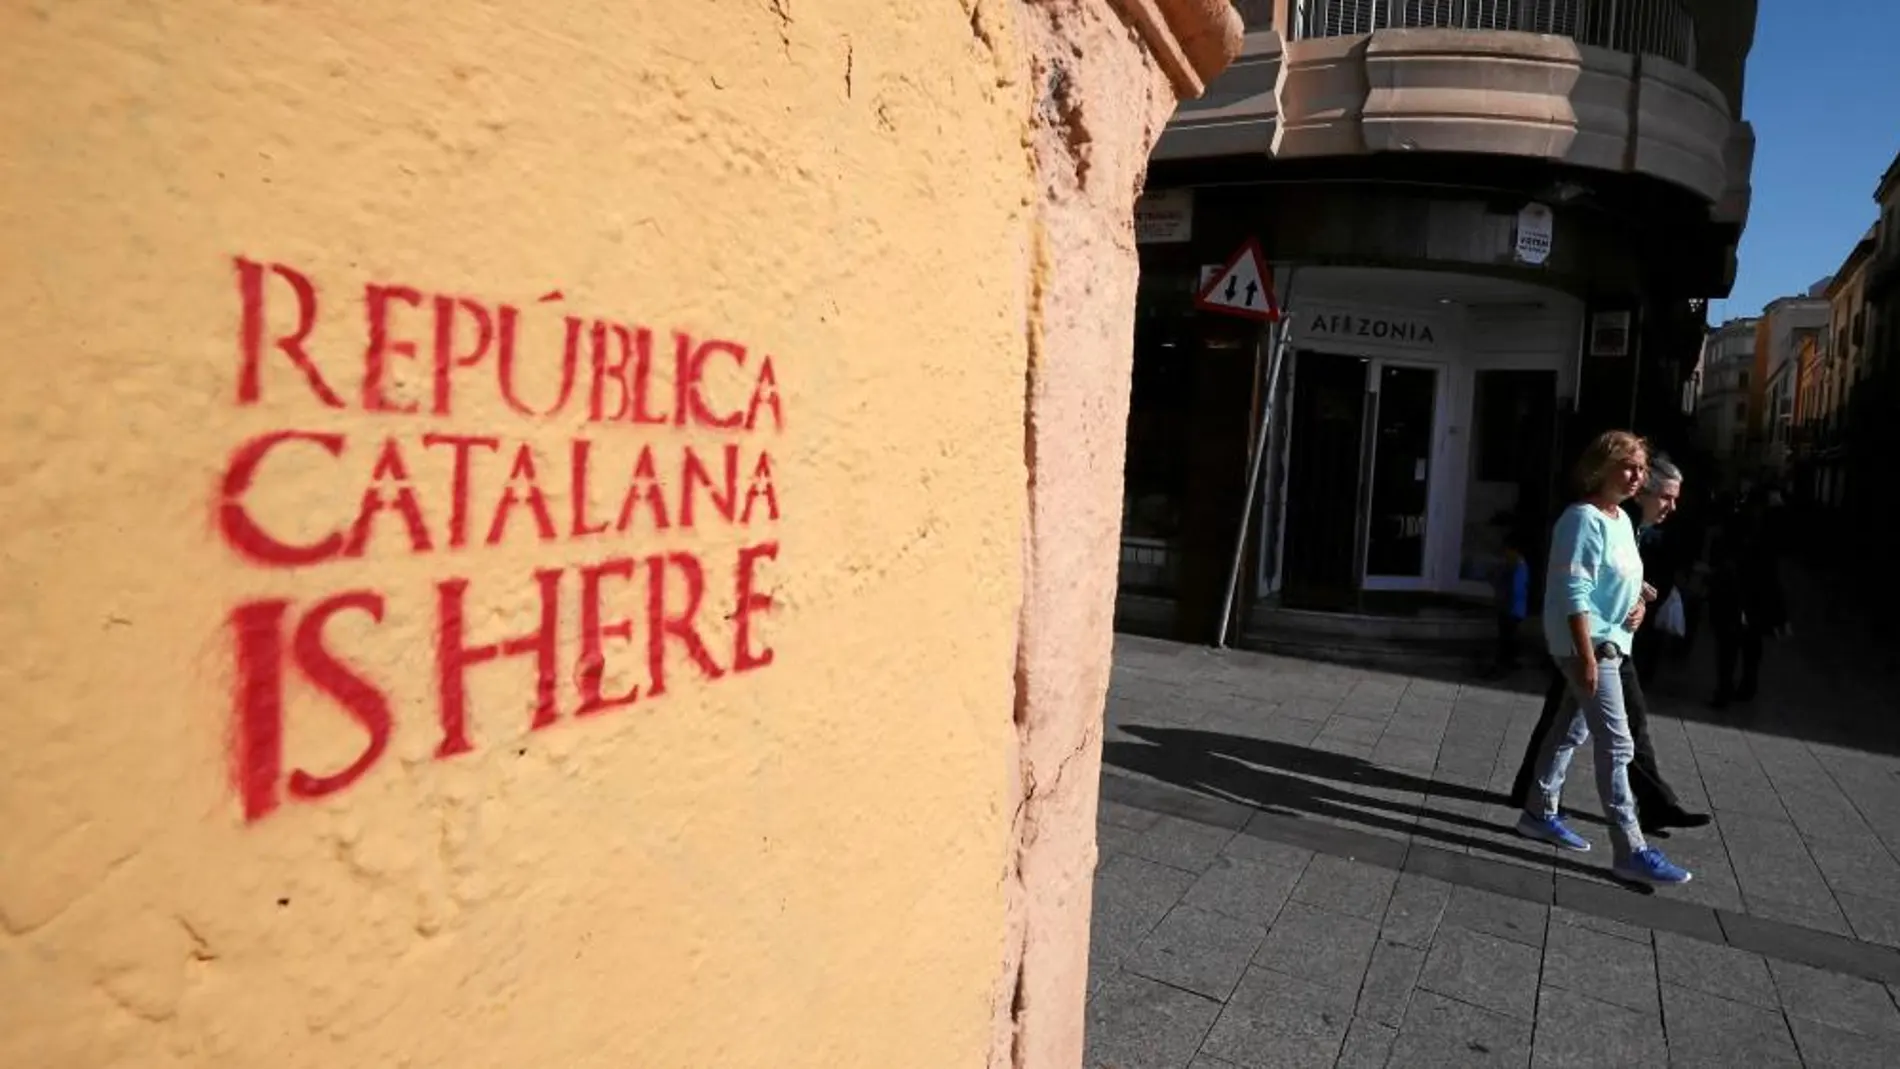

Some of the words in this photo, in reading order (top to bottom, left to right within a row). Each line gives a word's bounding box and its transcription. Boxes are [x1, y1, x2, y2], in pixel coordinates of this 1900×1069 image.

[232, 255, 783, 432] REPÚBLICA
[219, 429, 780, 567] CATALANA
[230, 588, 393, 825] IS
[434, 541, 780, 760] HERE
